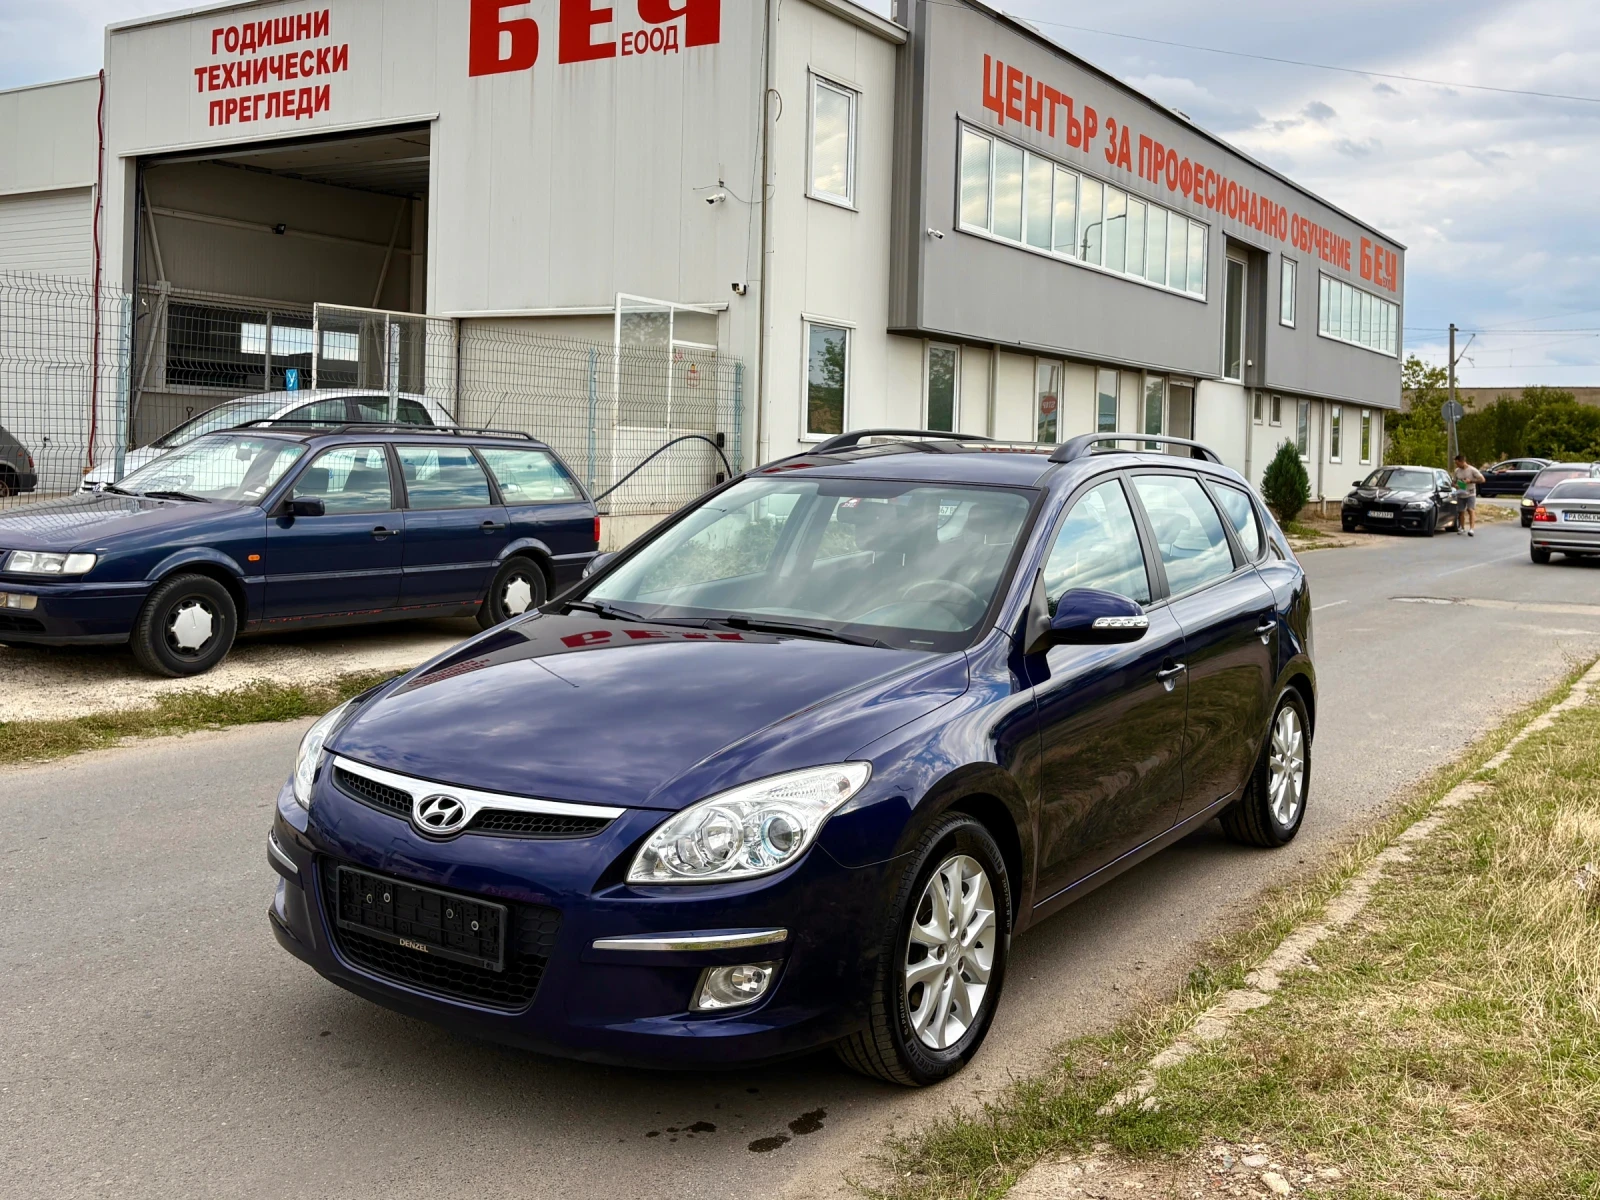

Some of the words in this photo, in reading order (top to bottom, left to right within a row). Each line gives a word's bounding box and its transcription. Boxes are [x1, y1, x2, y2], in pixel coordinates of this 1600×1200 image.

[212, 9, 329, 56] ГОДИШНИ
[621, 25, 679, 56] ЕООД
[194, 44, 349, 93] ТЕХНИЧЕСКИ
[209, 84, 330, 127] ПРЕГЛЕДИ
[982, 53, 1098, 154] ЦЕНТЪР
[1104, 117, 1132, 173] ЗА
[1138, 133, 1288, 243] ПРОФЕСИОНАЛНО
[1291, 212, 1351, 272] ОБУЧЕНИЕ
[1360, 235, 1397, 292] БЕЧ
[399, 938, 429, 953] DENZEL
